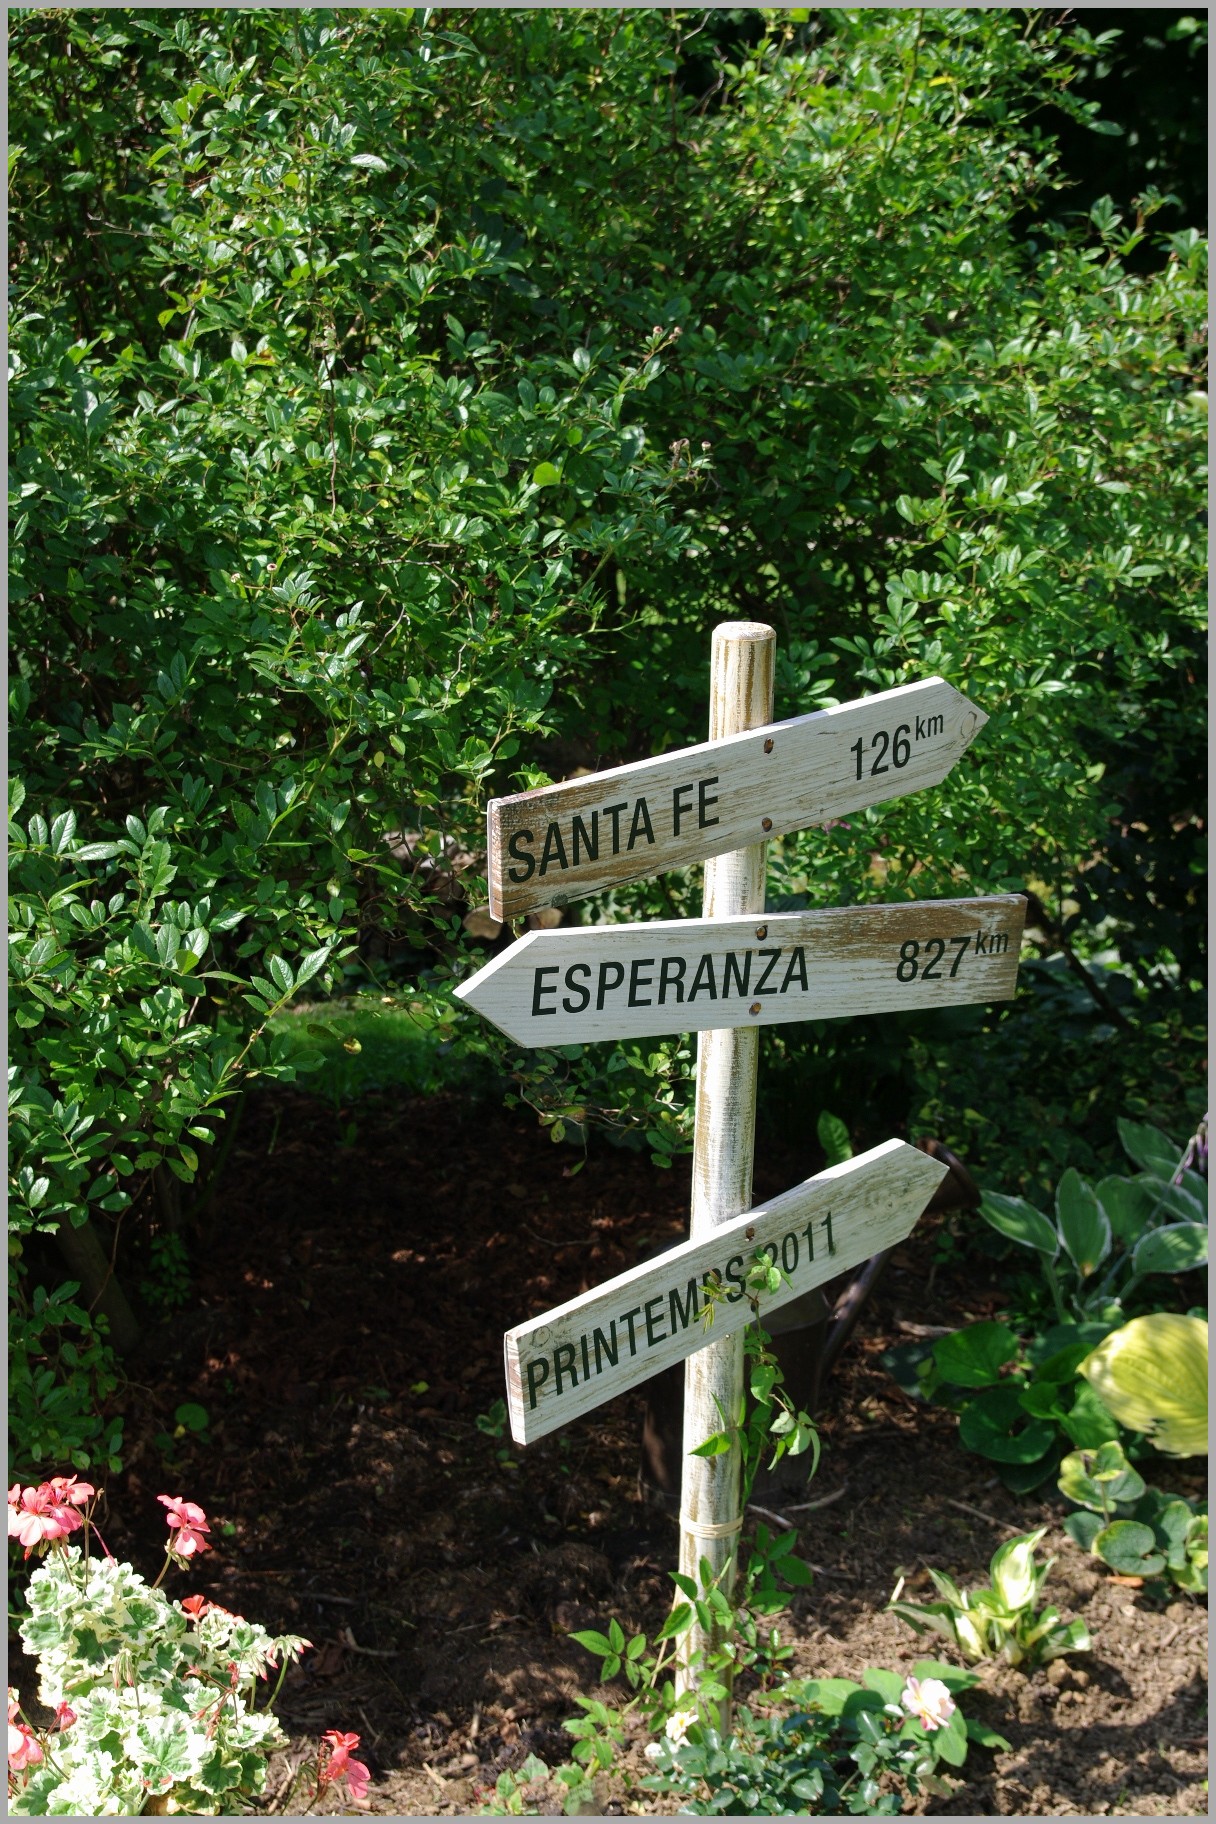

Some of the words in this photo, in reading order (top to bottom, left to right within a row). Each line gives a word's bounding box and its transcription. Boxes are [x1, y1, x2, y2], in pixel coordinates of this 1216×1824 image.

[508, 797, 655, 883] SANTA
[673, 776, 720, 837] FE
[531, 946, 810, 1017] ESPERANZA
